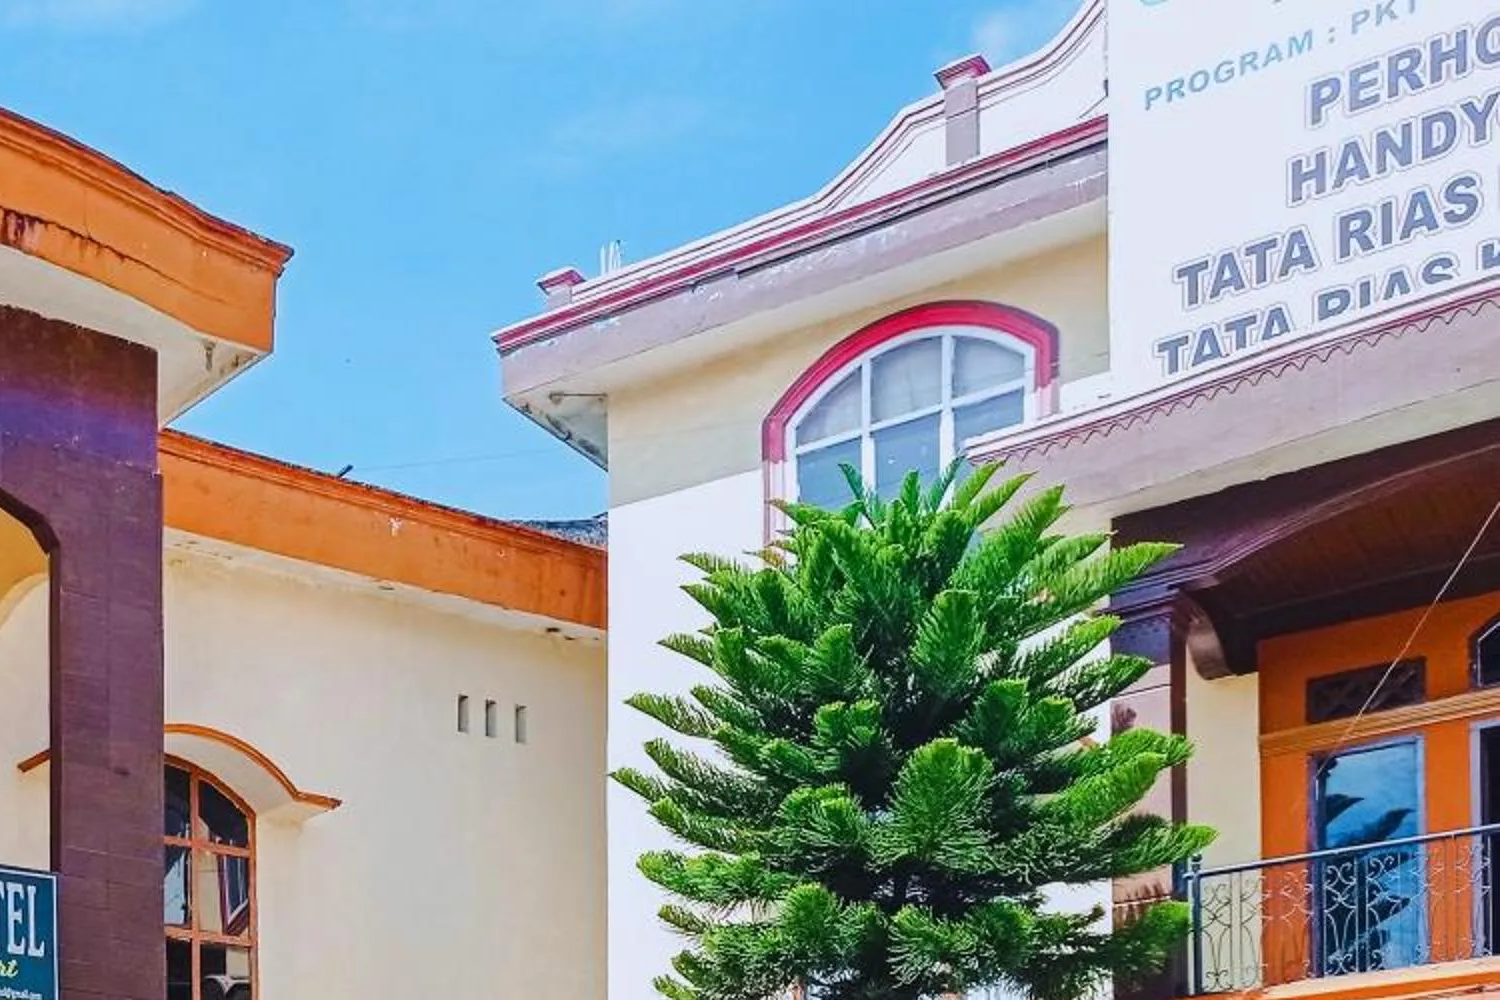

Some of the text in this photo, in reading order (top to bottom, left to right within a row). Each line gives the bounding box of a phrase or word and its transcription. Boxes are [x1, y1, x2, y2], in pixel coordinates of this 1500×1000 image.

[1144, 29, 1313, 111] PROGRAM
[1177, 175, 1479, 307] TATA RIAS
[1157, 307, 1291, 376] TATA
